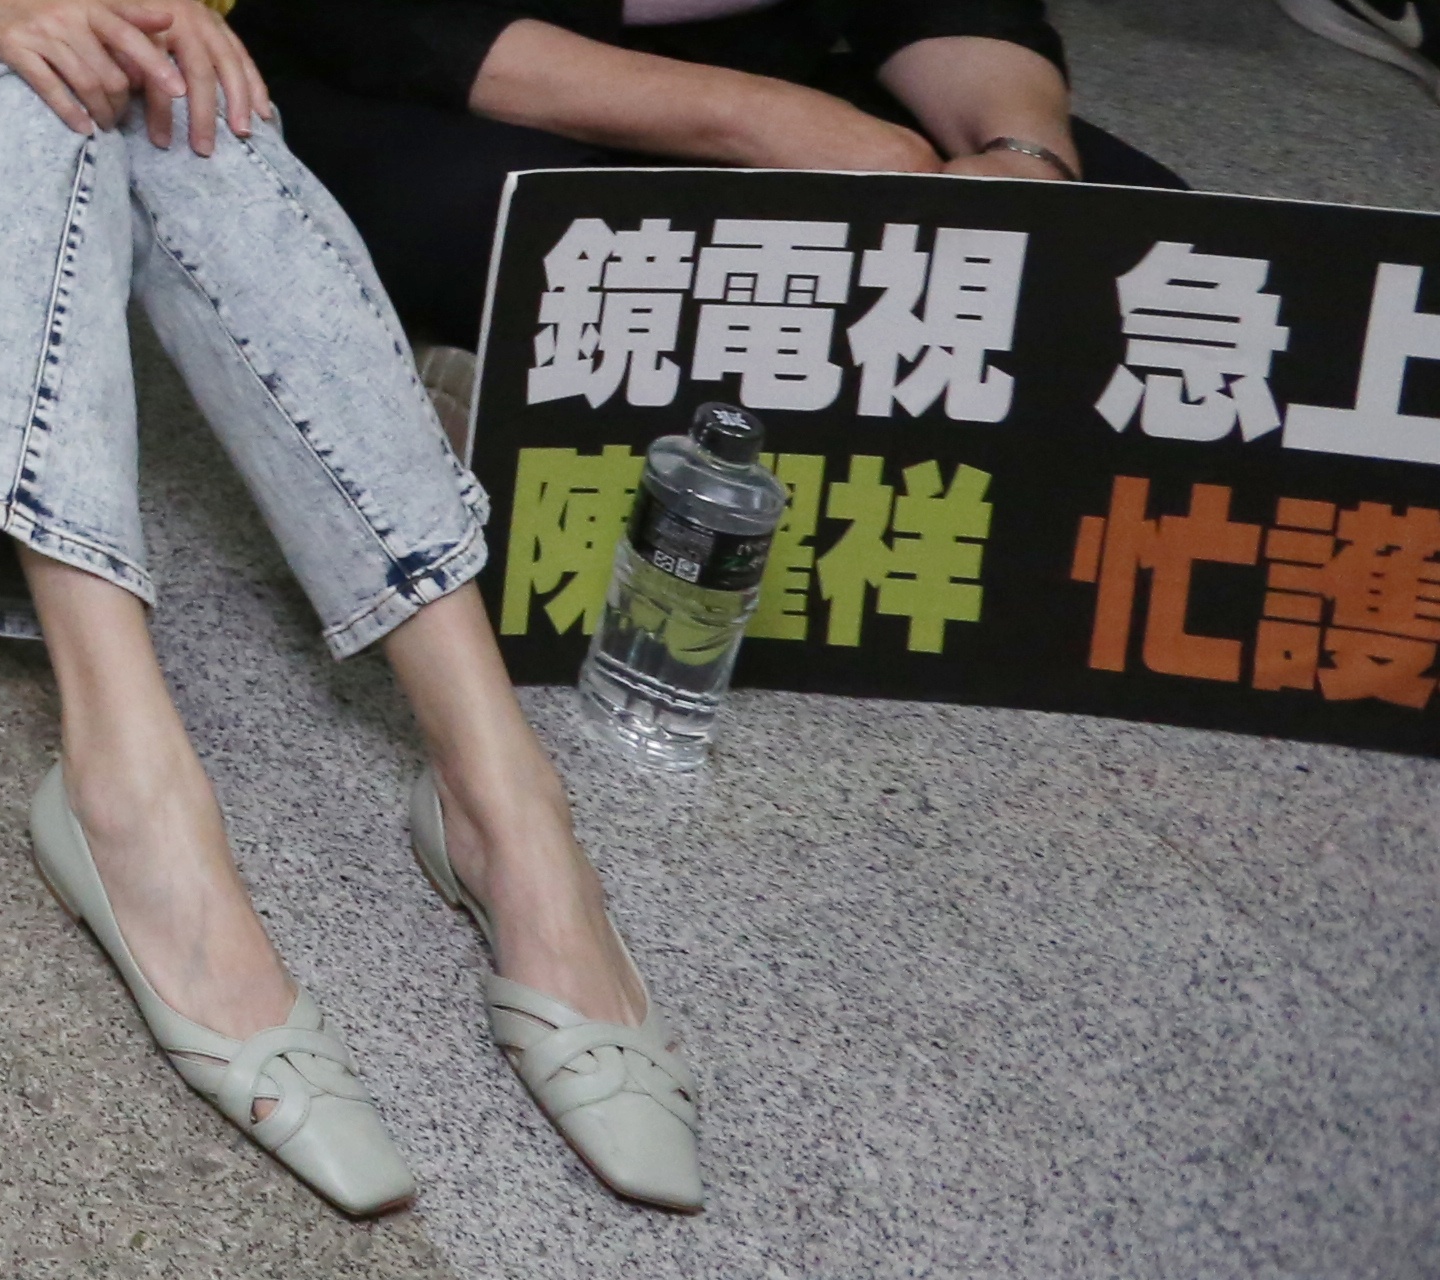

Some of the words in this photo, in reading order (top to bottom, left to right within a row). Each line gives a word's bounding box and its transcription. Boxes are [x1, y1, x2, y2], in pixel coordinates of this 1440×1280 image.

[525, 217, 1030, 424] 鏡電視
[1070, 474, 1440, 710] 忙護
